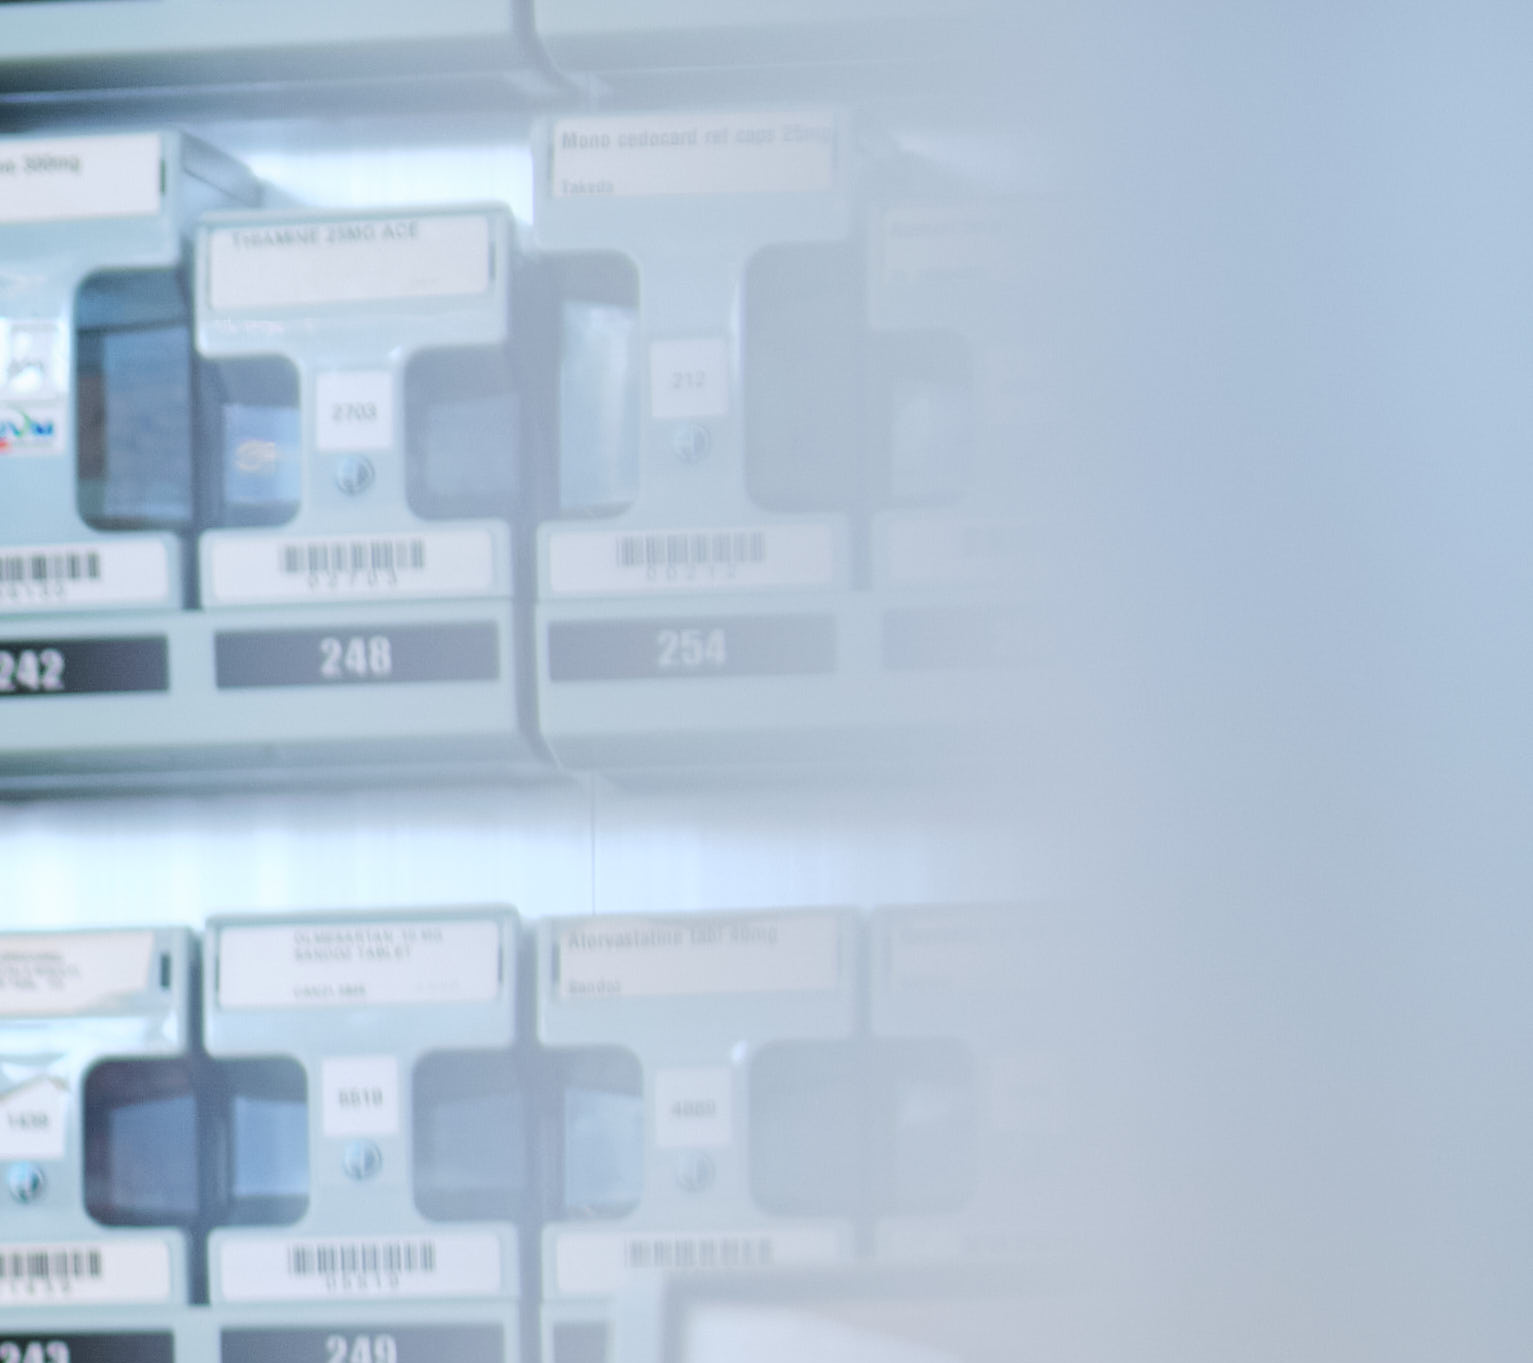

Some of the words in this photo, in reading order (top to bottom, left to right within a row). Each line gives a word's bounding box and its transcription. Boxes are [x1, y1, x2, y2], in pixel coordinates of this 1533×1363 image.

[562, 130, 611, 149] Mono
[671, 369, 707, 390] 212
[330, 402, 379, 423] 2703
[319, 634, 394, 679] 248
[656, 626, 729, 670] 254
